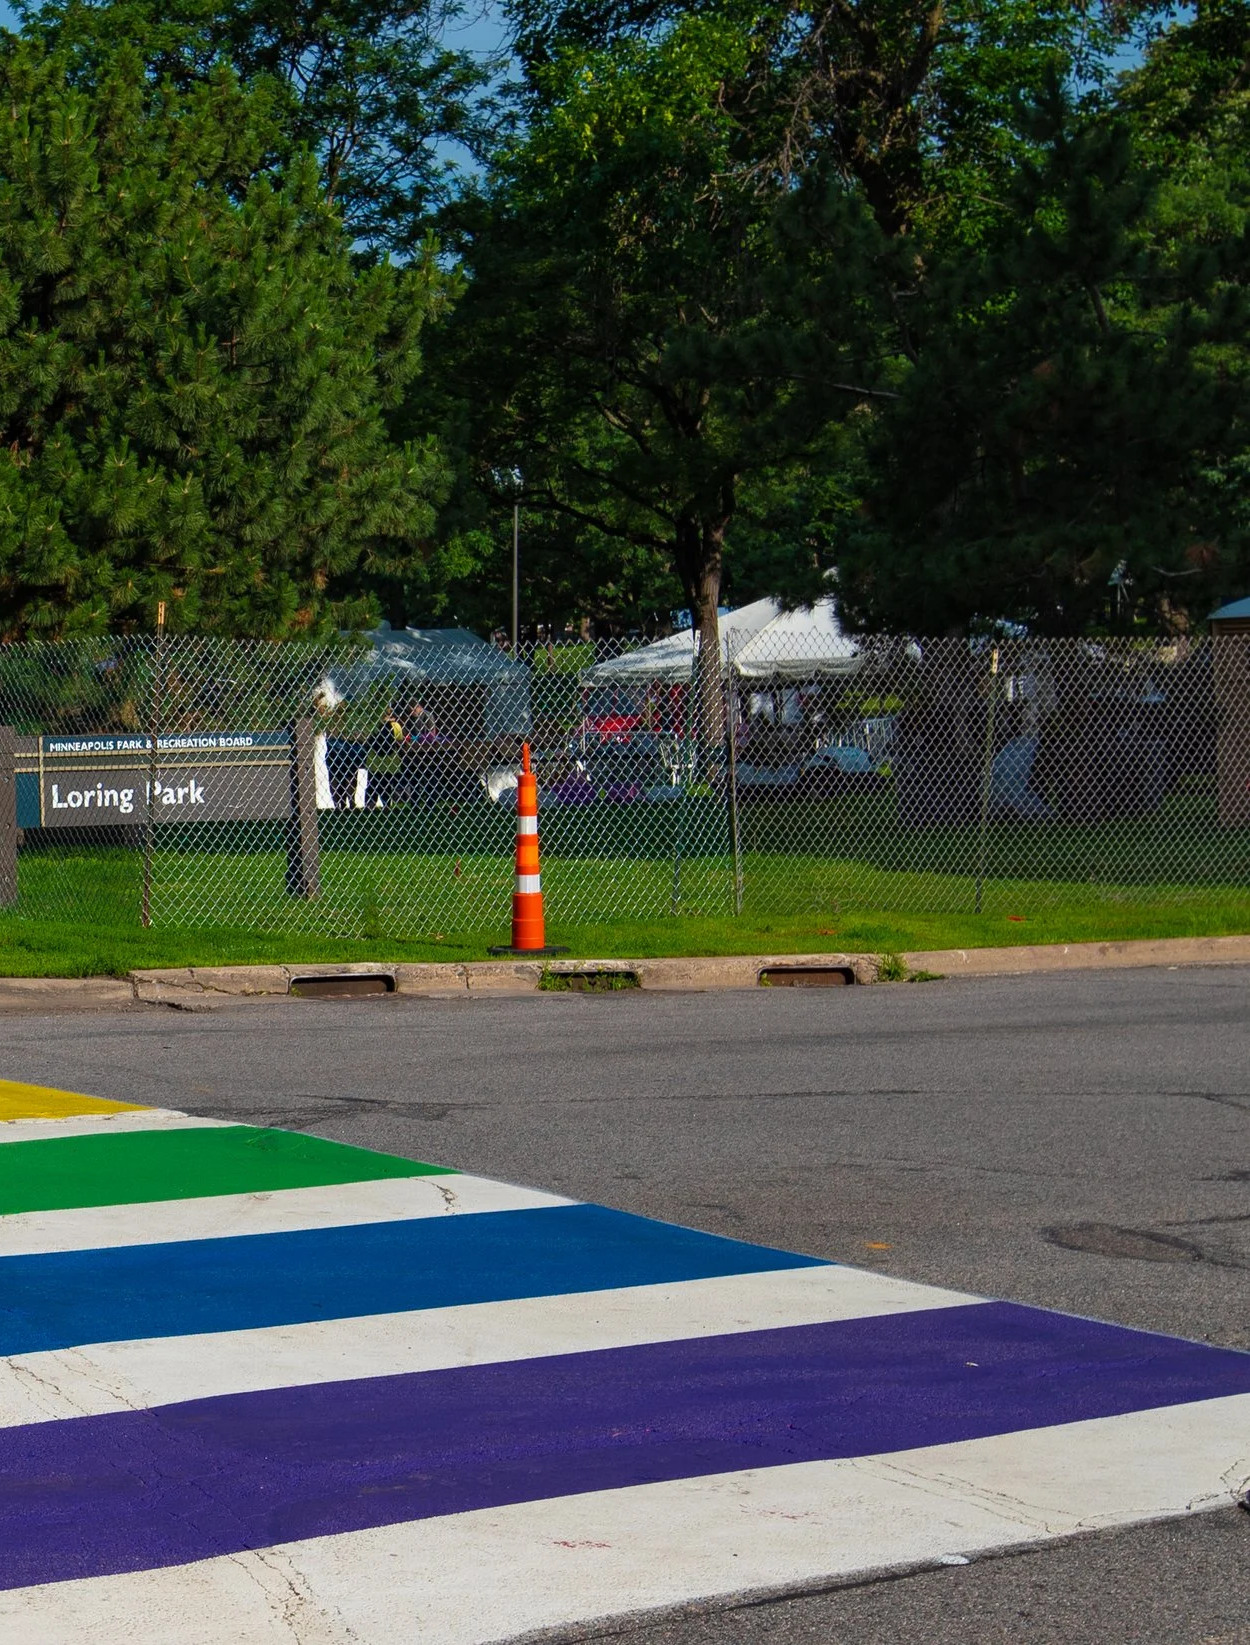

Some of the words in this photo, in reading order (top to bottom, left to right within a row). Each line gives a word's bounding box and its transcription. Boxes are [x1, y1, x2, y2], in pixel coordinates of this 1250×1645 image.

[50, 741, 114, 752] MINNEAPOLIS
[117, 740, 143, 750] PARK
[145, 740, 152, 749] &
[156, 738, 217, 748] RECREATION
[219, 737, 253, 747] BOARD
[51, 782, 134, 813] Loring
[146, 780, 205, 805] Park
